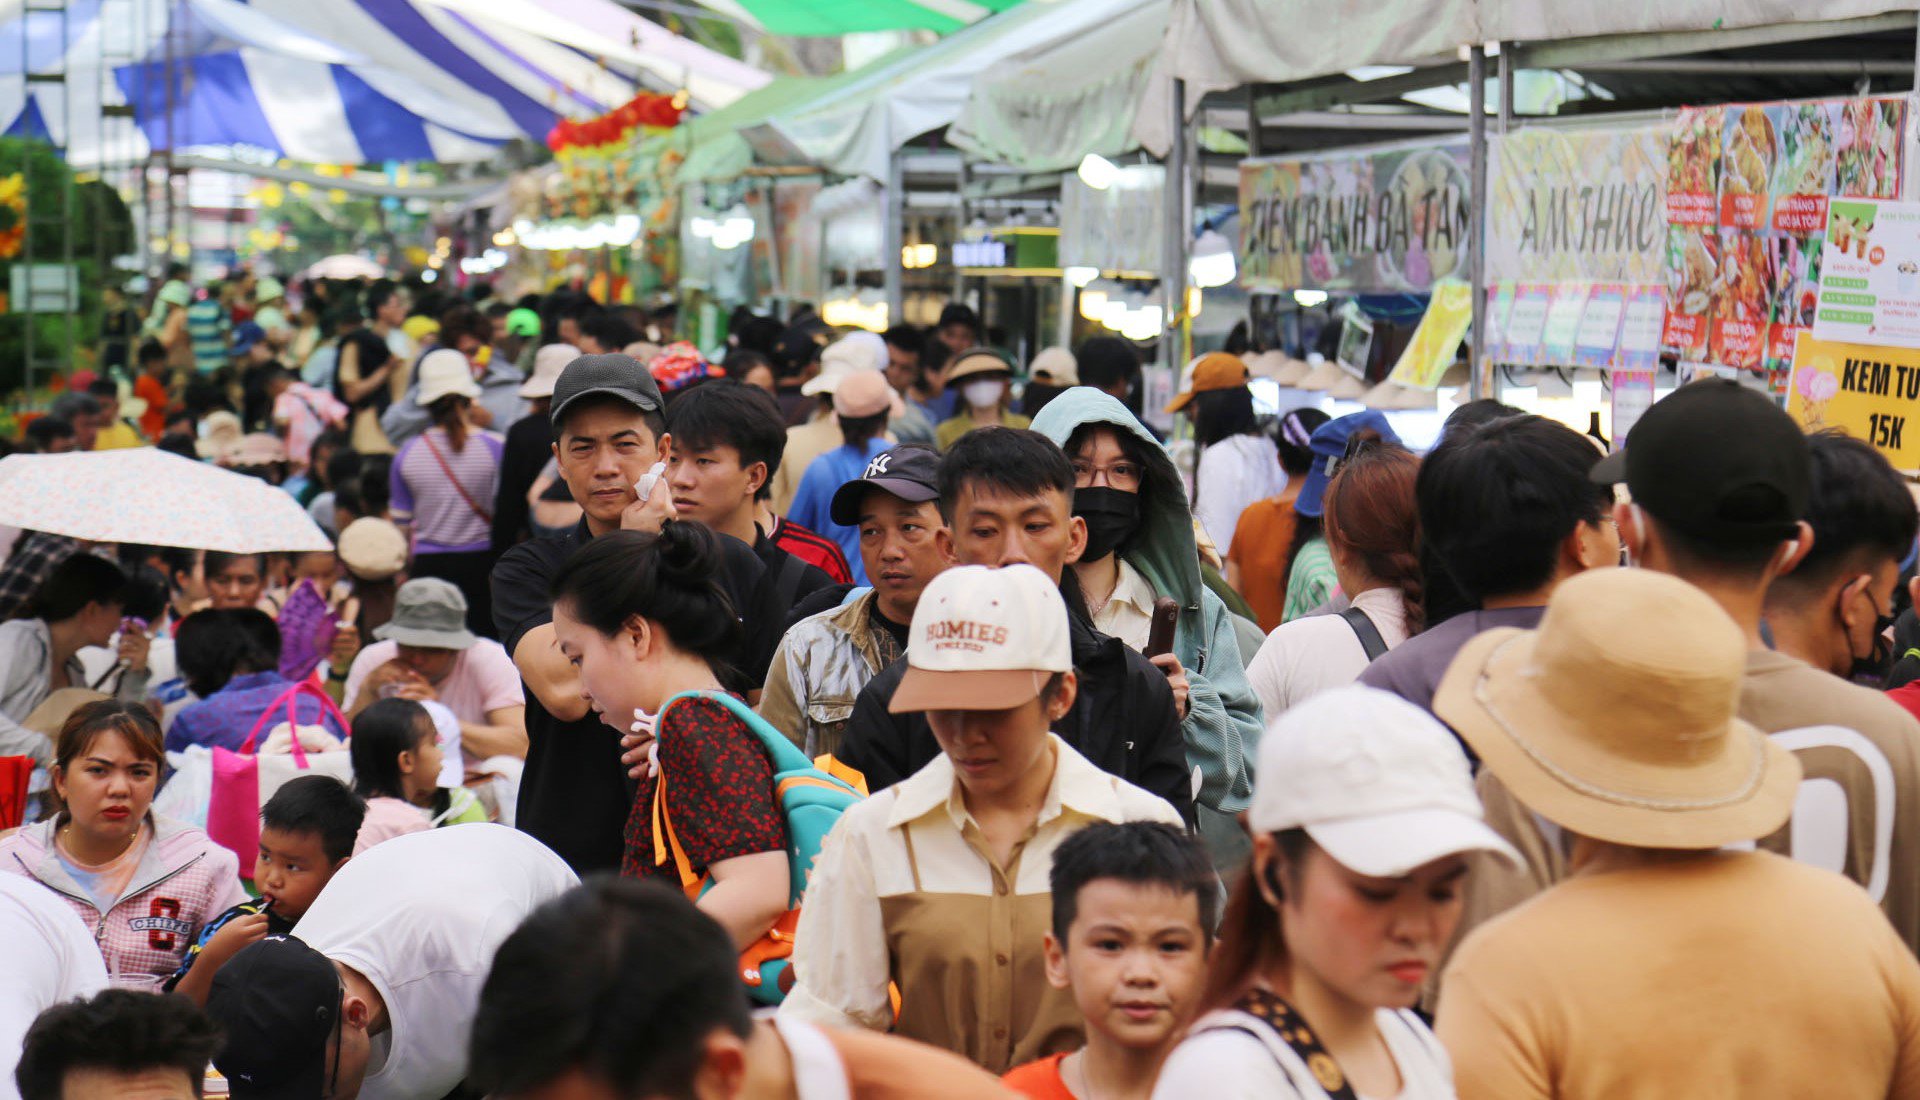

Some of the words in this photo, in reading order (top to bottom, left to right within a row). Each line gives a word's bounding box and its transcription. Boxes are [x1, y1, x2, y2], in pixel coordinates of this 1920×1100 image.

[1842, 358, 1891, 396] KEM
[1868, 413, 1905, 450] 15K
[927, 620, 1009, 645] HOMIES
[134, 919, 189, 933] CHIEFS
